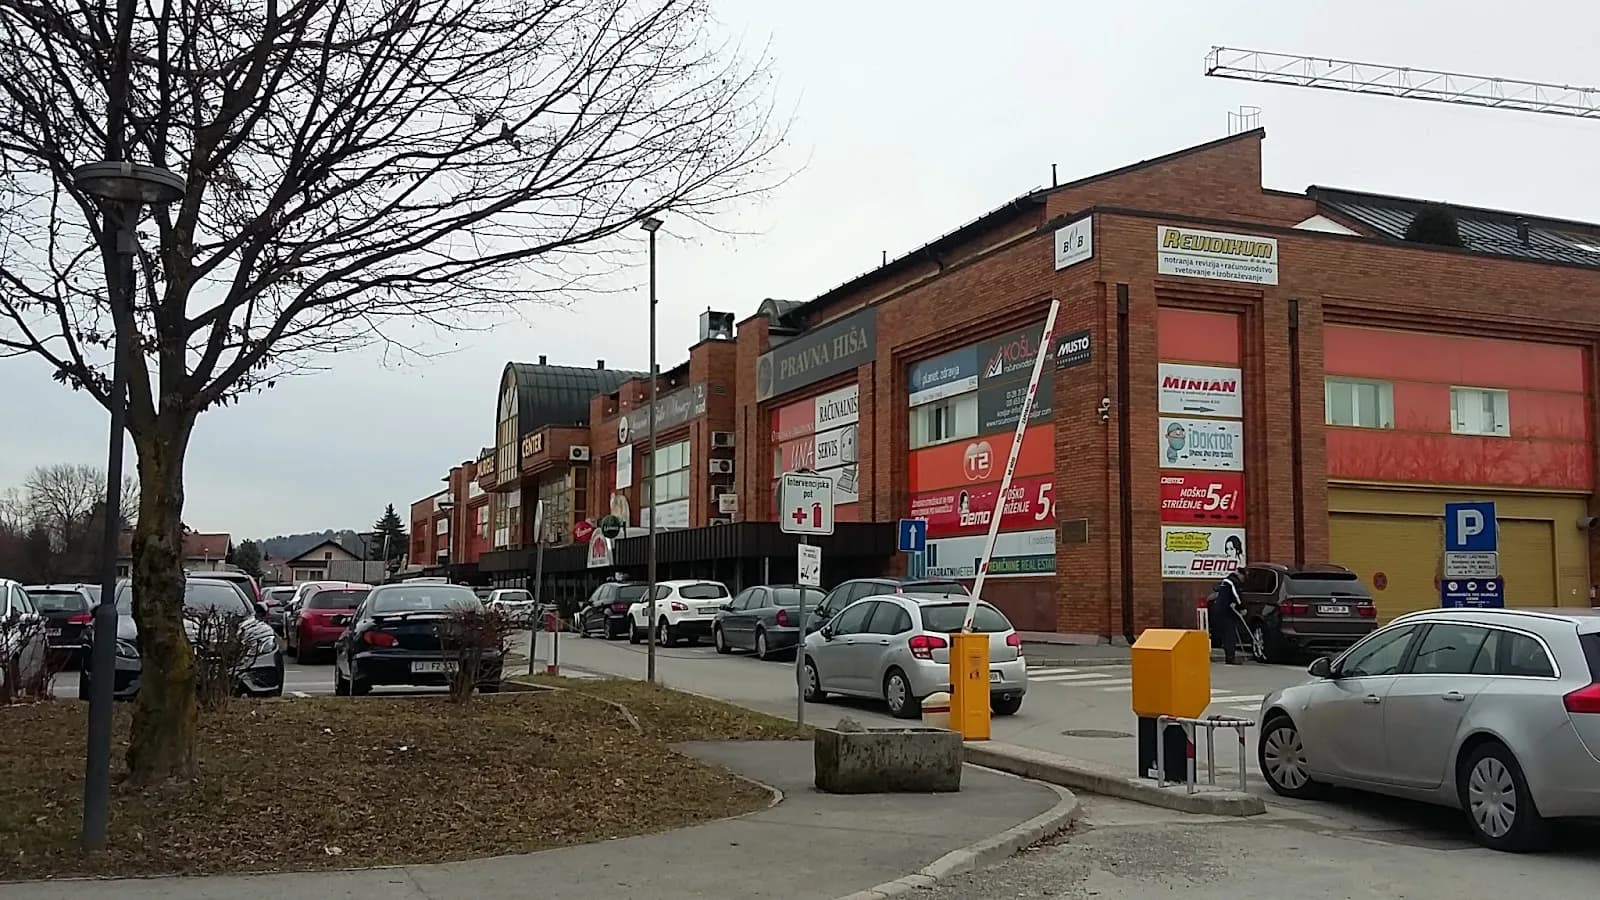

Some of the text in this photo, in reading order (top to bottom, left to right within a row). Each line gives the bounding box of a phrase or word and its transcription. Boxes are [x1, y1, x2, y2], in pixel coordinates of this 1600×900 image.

[1164, 257, 1193, 267] notranja
[1195, 259, 1220, 269] revizija
[1175, 267, 1263, 282] svetovanje izobraževanje
[780, 325, 867, 380] PRAVNA HIŠA
[1057, 337, 1089, 357] MUSTO
[1162, 377, 1237, 392] MINIAN
[819, 391, 857, 422] RAČUNALNIŠ
[521, 433, 543, 458] CENTER
[818, 439, 838, 459] SERVIS
[969, 453, 988, 471] T2
[787, 478, 829, 490] Intervencijska
[803, 489, 813, 499] pot
[1006, 485, 1025, 499] OŠKO
[1180, 487, 1206, 498] MOŠKO
[1003, 499, 1031, 514] RIŽENJE
[1162, 498, 1202, 509] STRIŽENJE
[1457, 509, 1484, 545] P
[1021, 560, 1037, 570] REAL
[1037, 559, 1055, 569] ESTAT
